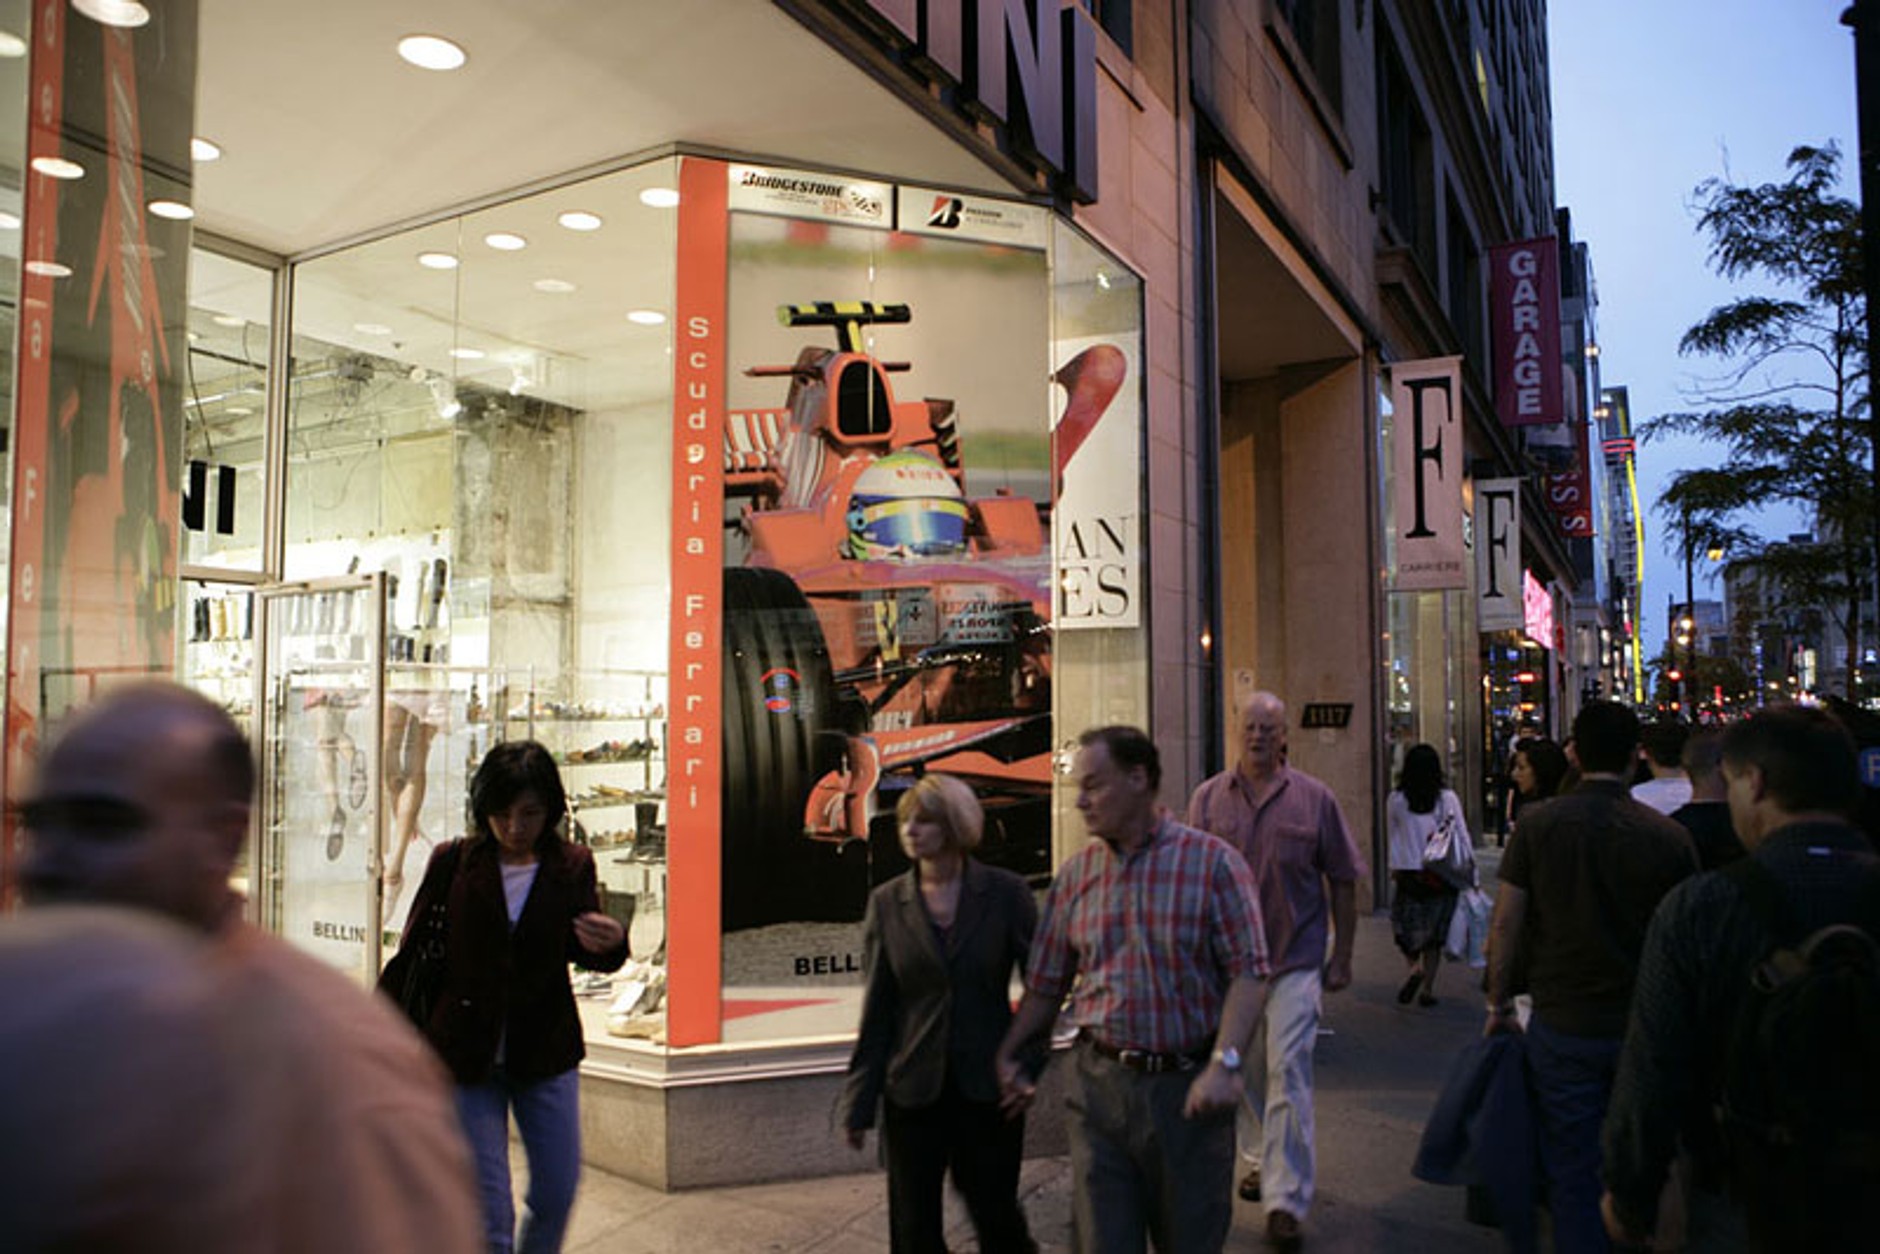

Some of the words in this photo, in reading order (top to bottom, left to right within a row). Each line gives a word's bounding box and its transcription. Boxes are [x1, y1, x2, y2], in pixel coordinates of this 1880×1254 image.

[1508, 250, 1542, 415] GARAGE
[1401, 376, 1454, 540] F
[1059, 563, 1130, 618] ES
[1060, 516, 1136, 560] AN
[1480, 490, 1515, 598] F
[684, 594, 704, 808] Ferrari
